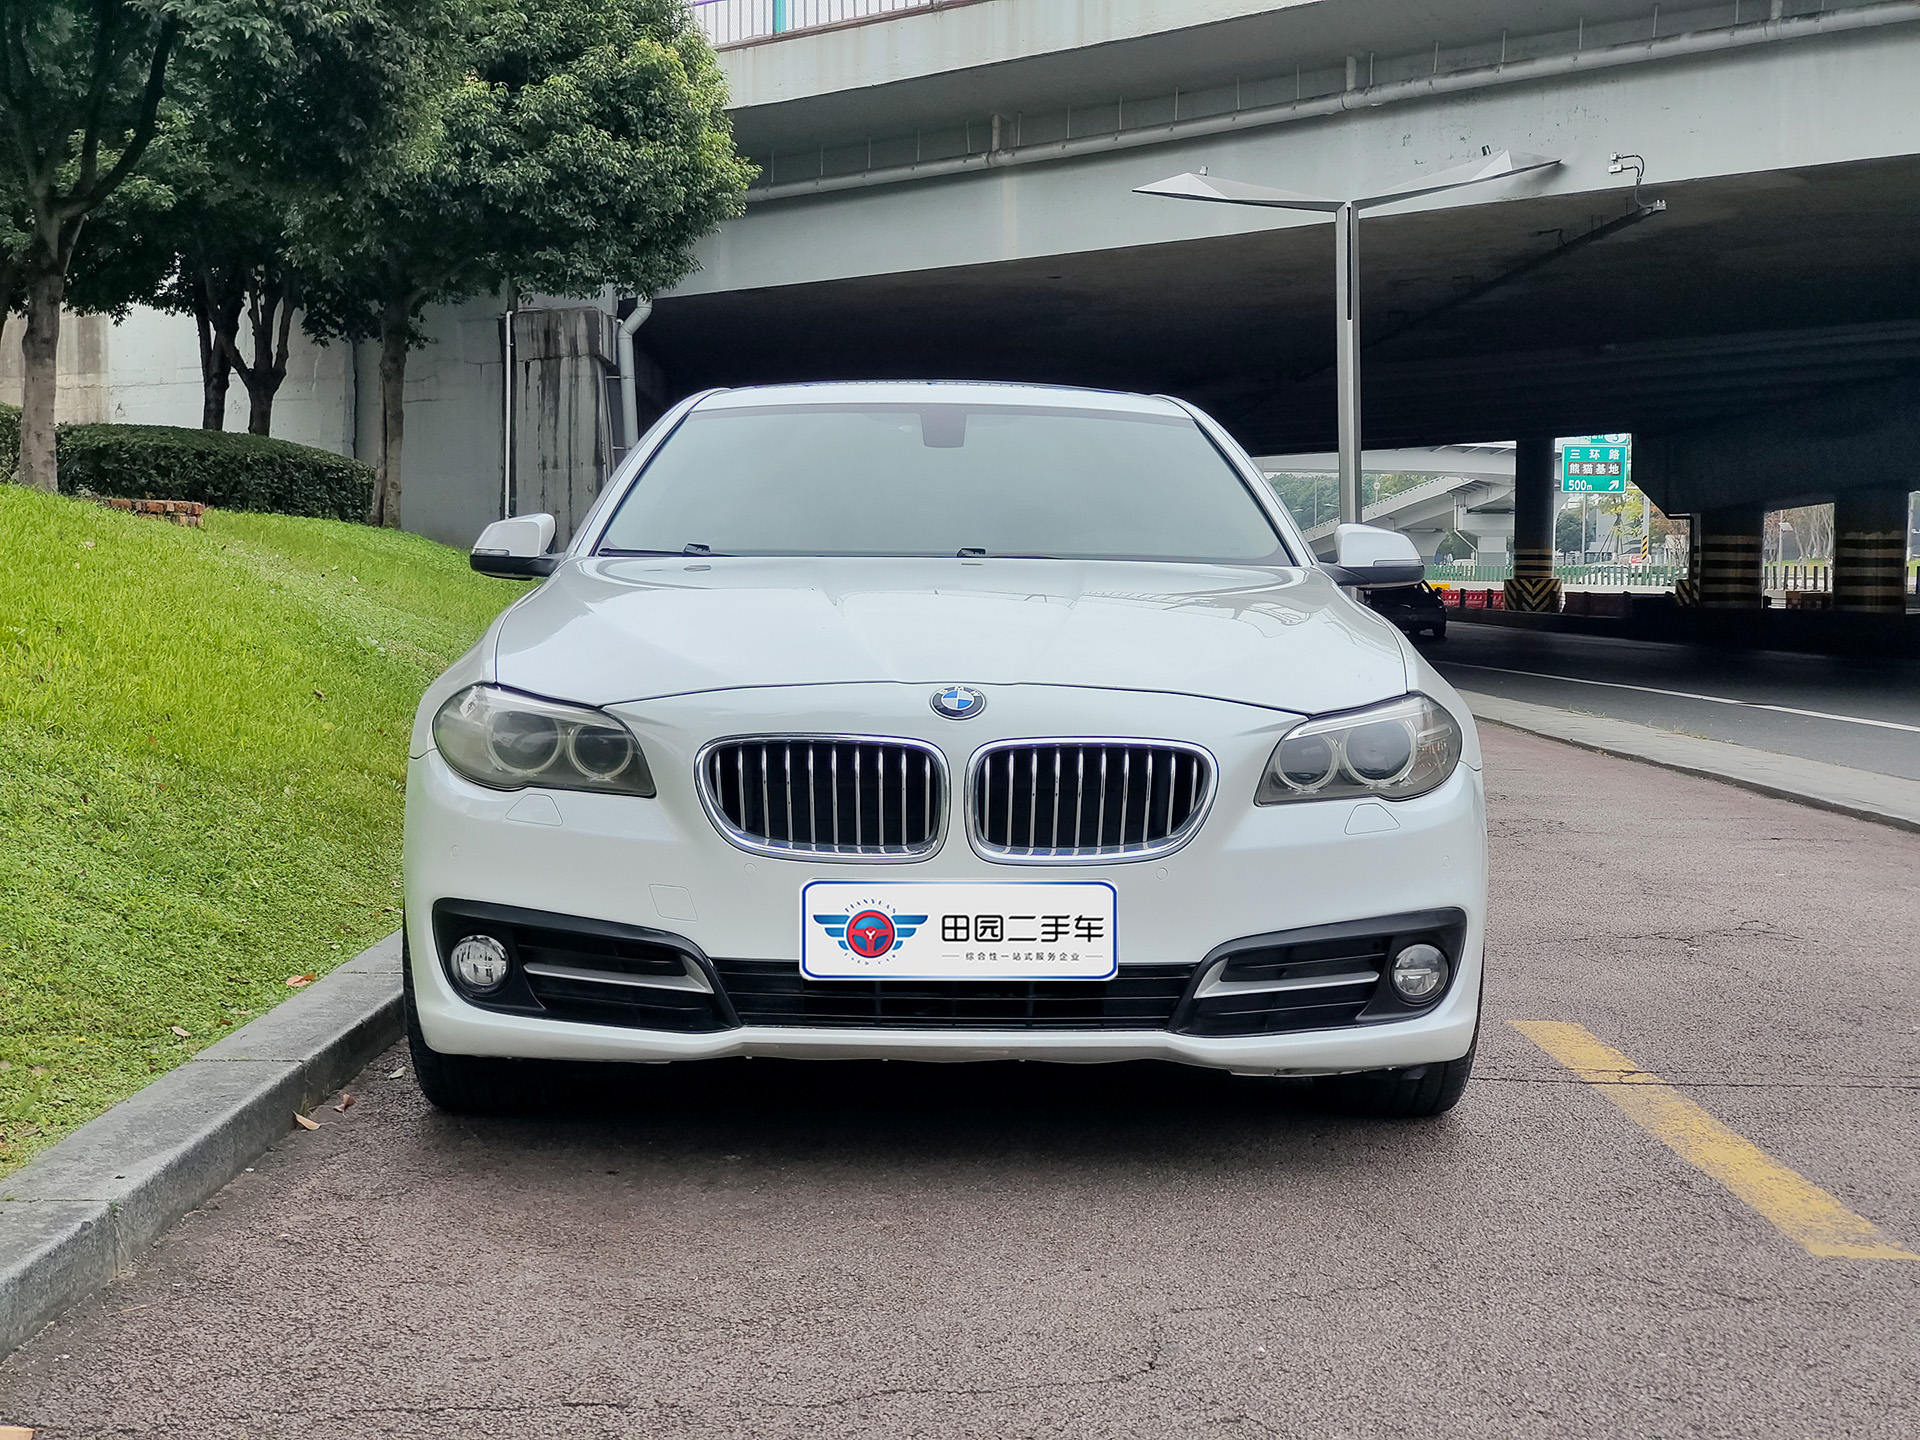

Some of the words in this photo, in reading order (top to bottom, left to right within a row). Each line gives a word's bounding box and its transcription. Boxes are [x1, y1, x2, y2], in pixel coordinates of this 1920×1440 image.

[1570, 449, 1619, 460] 三环路
[1569, 463, 1620, 475] 熊猫基地
[1568, 480, 1593, 491] 500m
[937, 686, 981, 697] BMW
